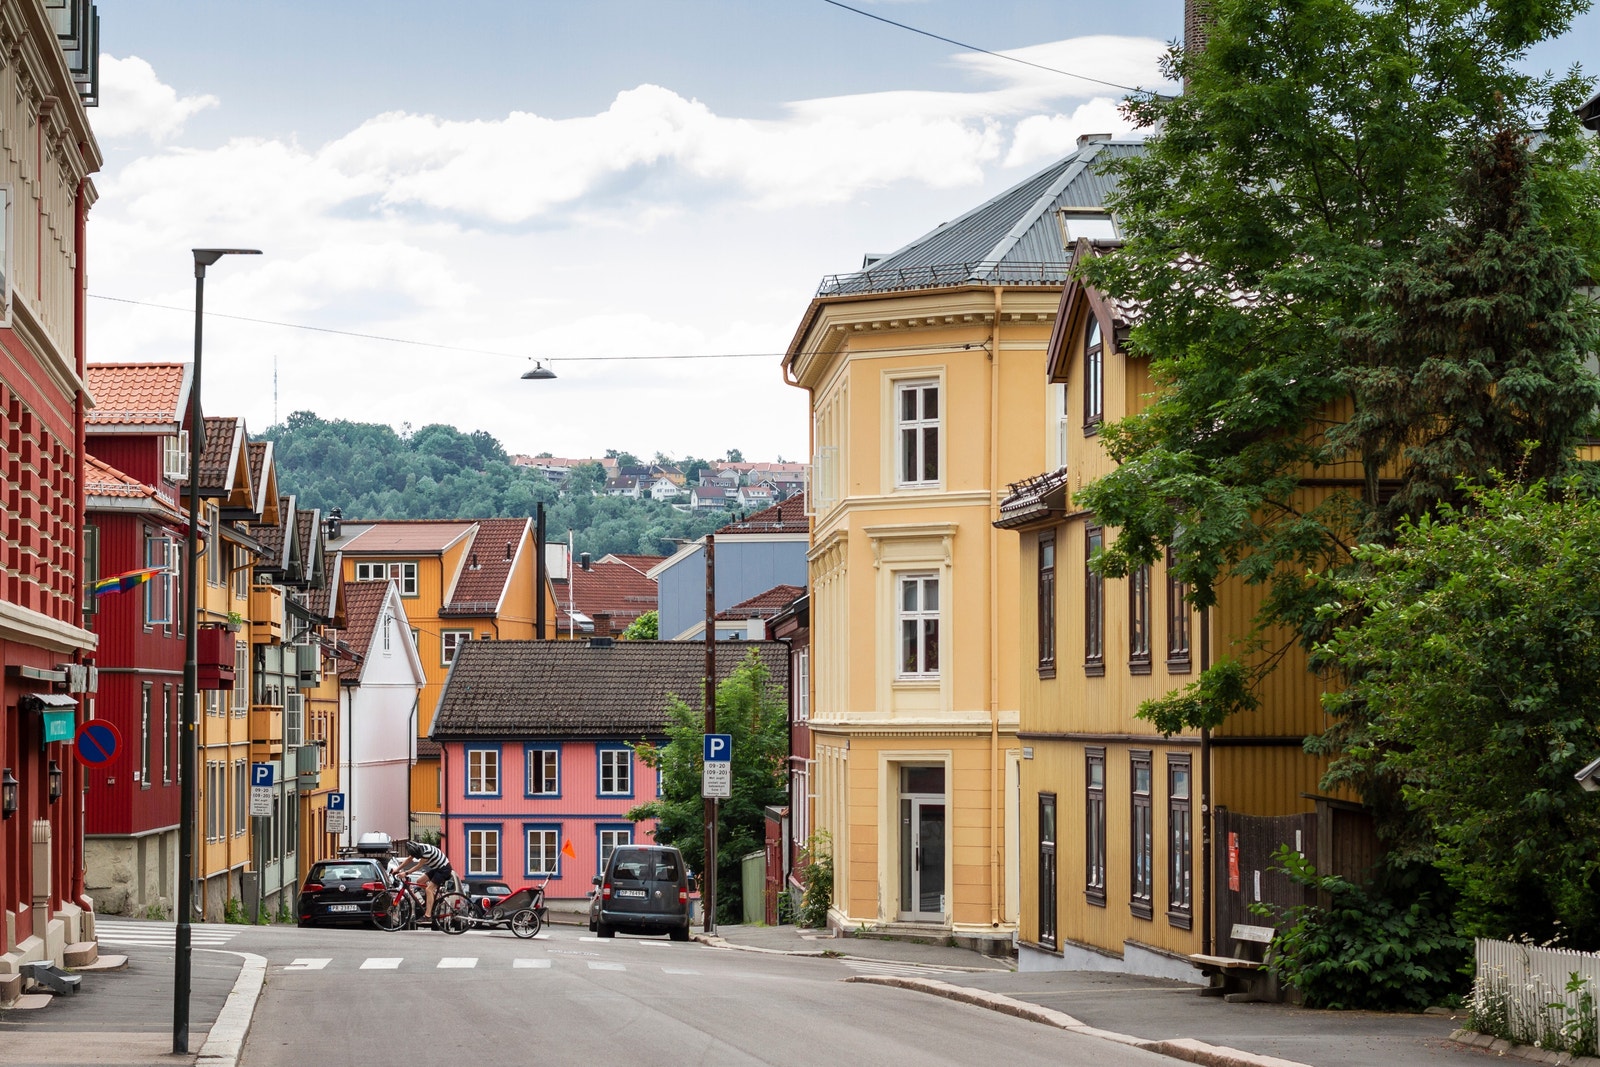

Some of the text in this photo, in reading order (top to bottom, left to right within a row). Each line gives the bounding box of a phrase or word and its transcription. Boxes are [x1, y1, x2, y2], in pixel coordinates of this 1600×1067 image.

[710, 738, 724, 758] P
[256, 767, 268, 784] P
[331, 794, 341, 808] P
